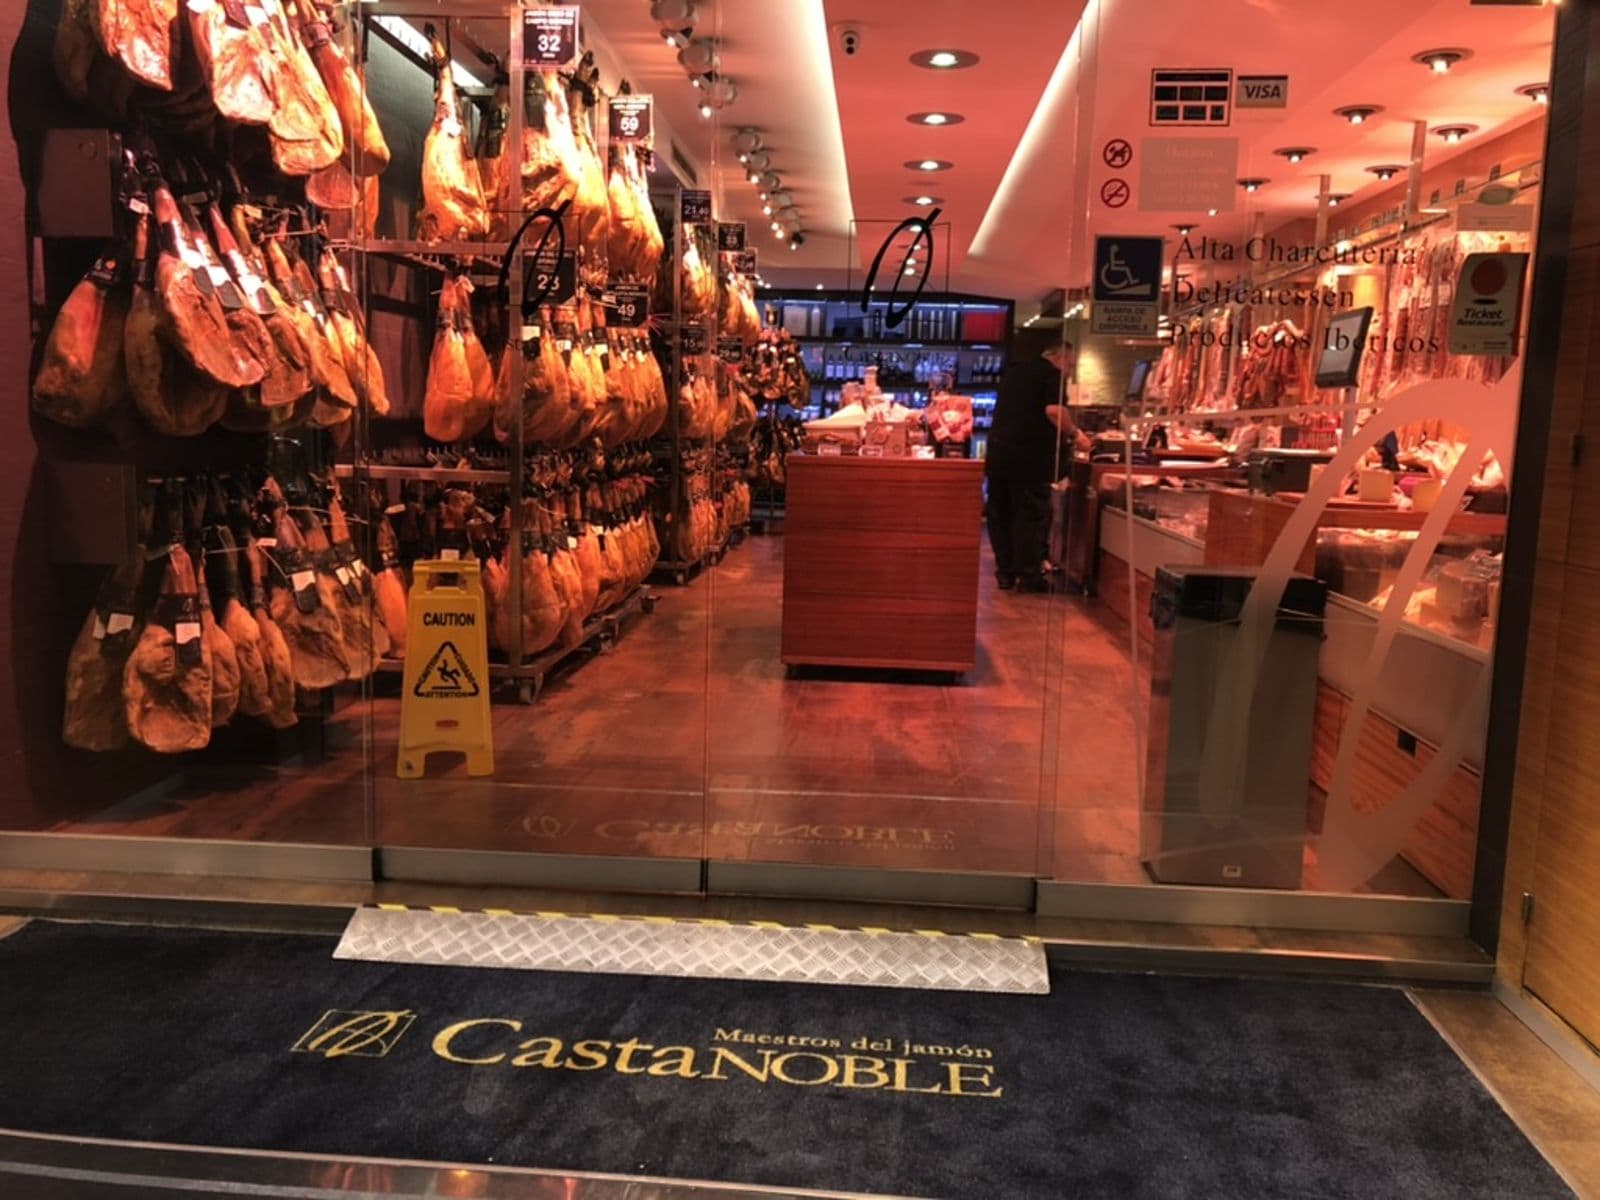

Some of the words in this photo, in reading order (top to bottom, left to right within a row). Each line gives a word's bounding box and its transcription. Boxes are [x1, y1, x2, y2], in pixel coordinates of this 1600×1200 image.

[537, 34, 561, 52] 32
[1244, 84, 1280, 99] VISA
[1175, 235, 1234, 261] Alta
[1173, 280, 1354, 307] Delicatessen
[617, 303, 635, 317] 49
[1463, 308, 1503, 320] Ticket
[1168, 321, 1311, 348] Productos
[423, 612, 475, 627] CAUTION
[713, 1027, 841, 1049] Maestros
[851, 1036, 892, 1051] del
[904, 1038, 993, 1059] jamón
